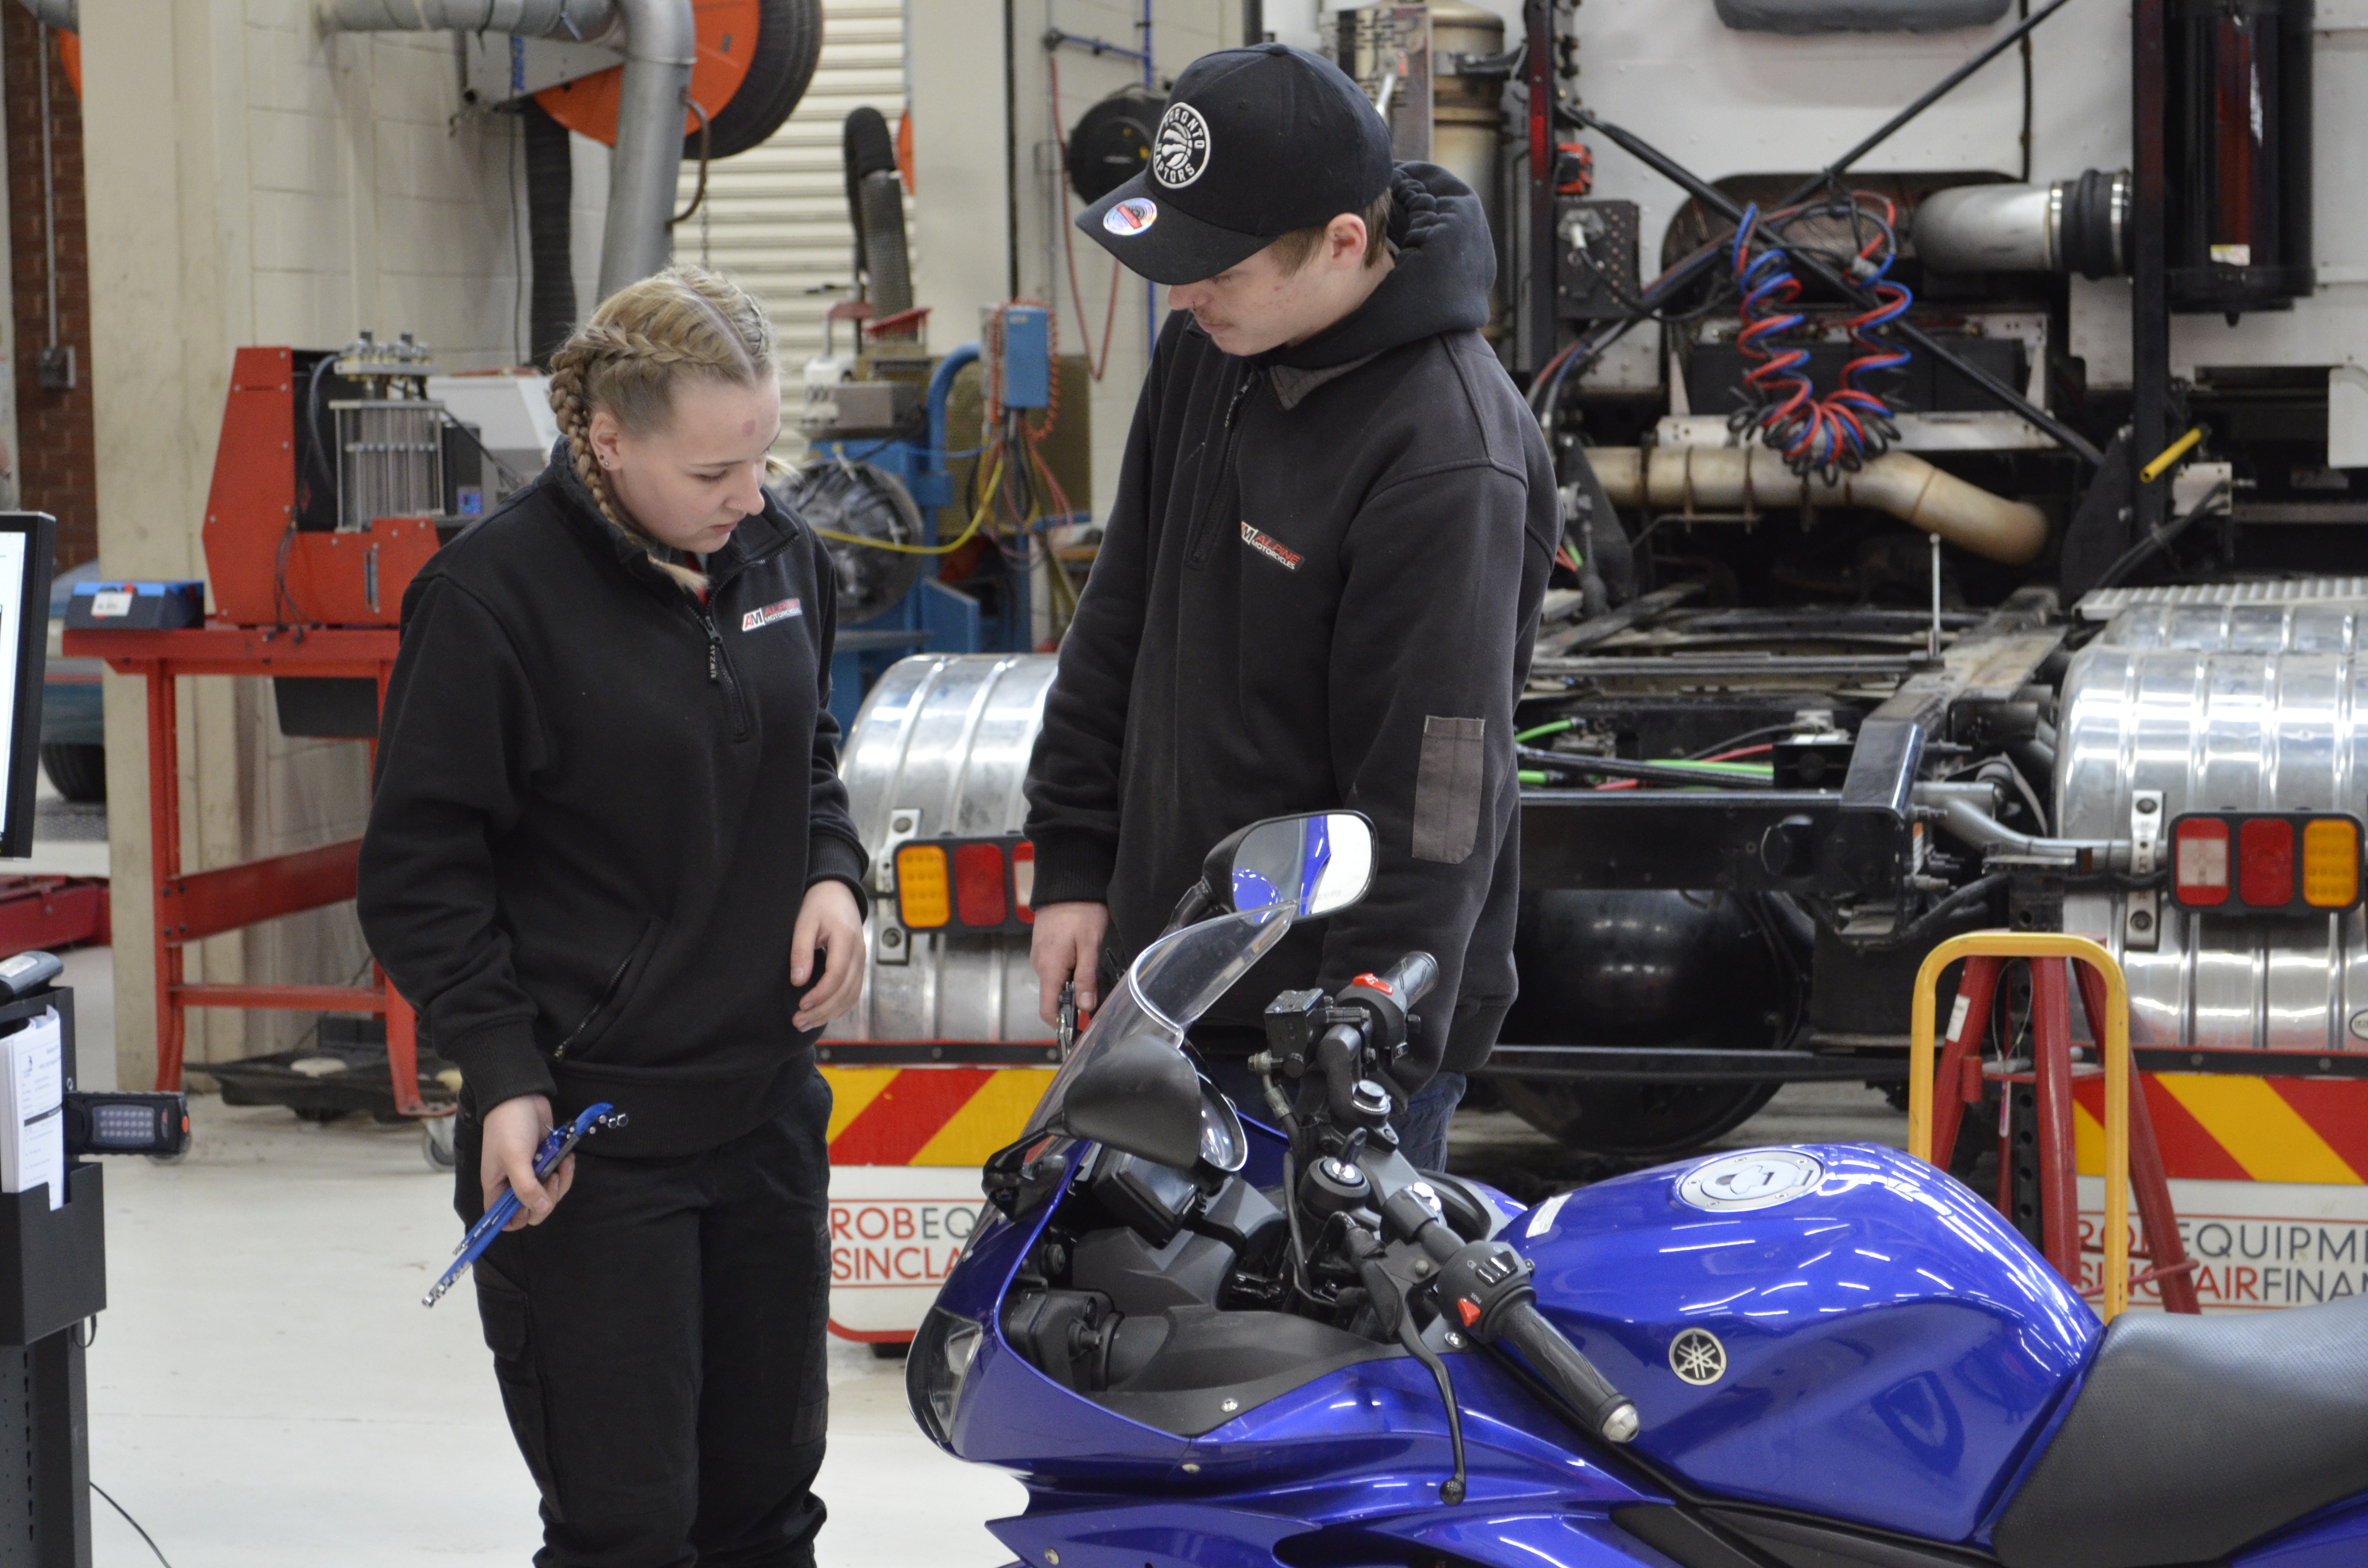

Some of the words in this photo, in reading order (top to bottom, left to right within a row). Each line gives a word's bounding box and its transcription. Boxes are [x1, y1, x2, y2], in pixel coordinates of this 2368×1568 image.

[1163, 108, 1205, 149] TORONTO
[1155, 143, 1195, 184] RAPTORS
[1251, 539, 1295, 570] MOTORCYCLES
[1254, 535, 1301, 564] ALPINE
[744, 611, 763, 628] AM
